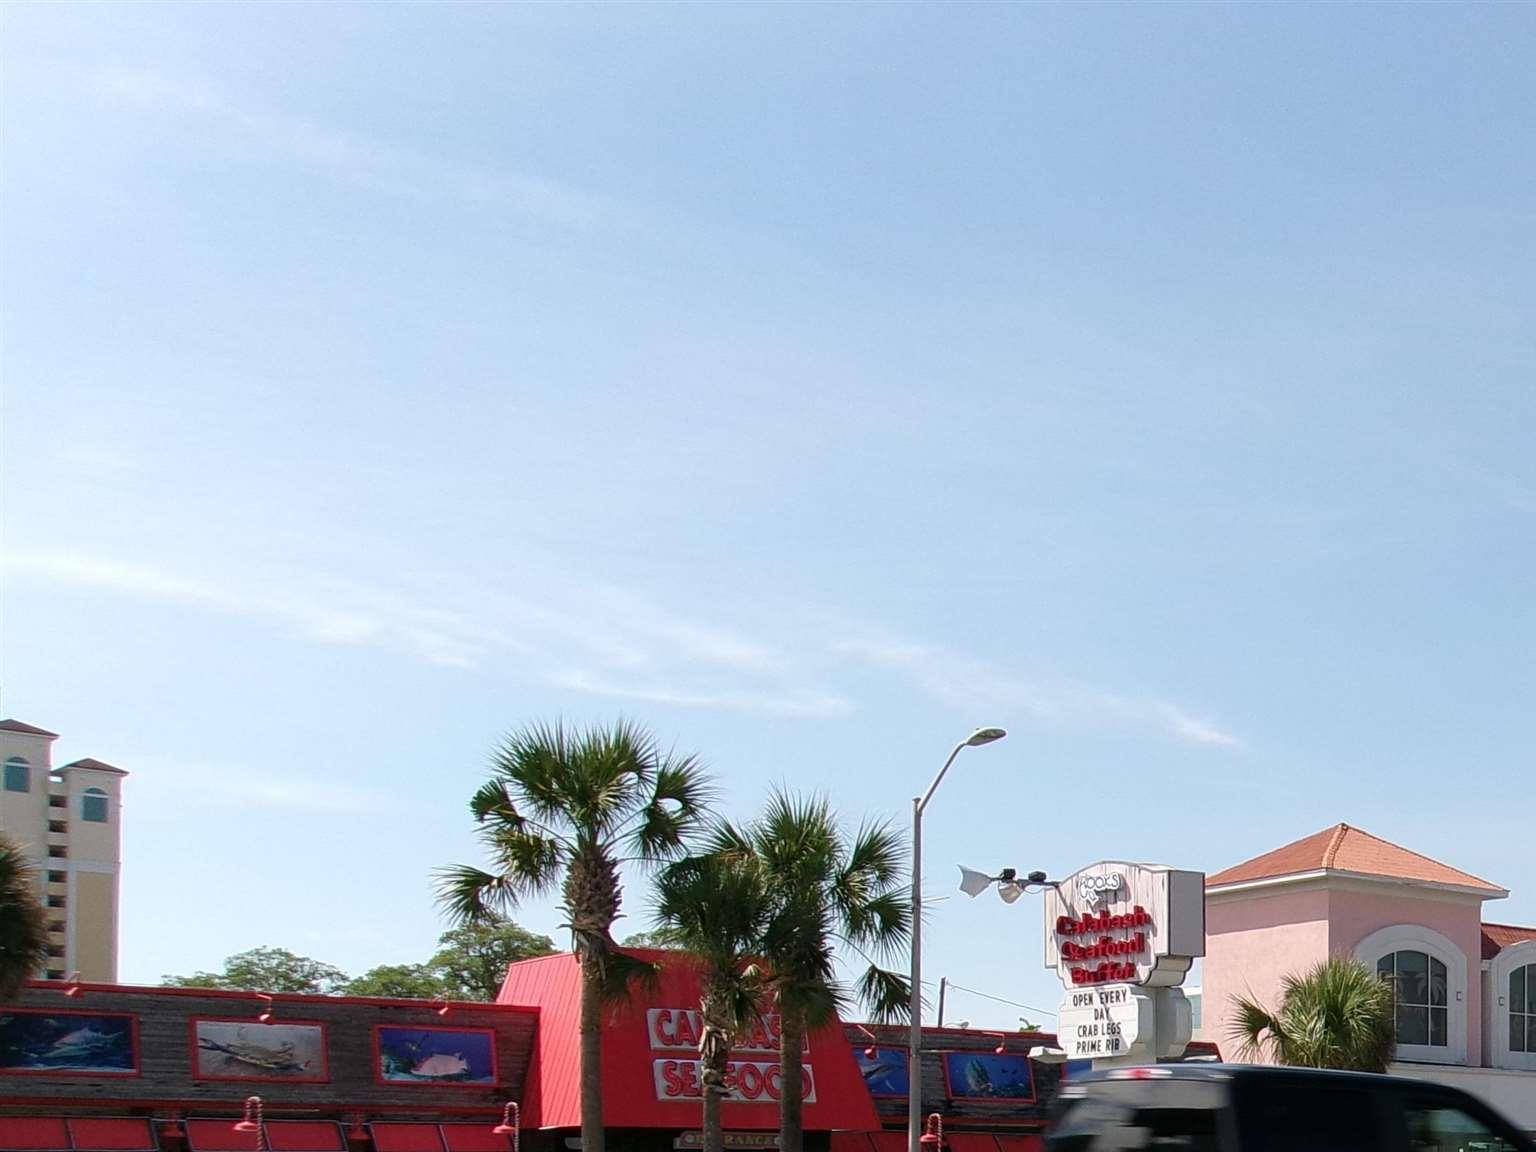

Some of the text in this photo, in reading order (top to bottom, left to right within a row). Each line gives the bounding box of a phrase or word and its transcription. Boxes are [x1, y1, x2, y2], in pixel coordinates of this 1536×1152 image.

[1061, 932, 1145, 961] Seafood
[1073, 989, 1127, 1007] OPEN EVERY
[1094, 1008, 1110, 1020] DAY
[656, 1010, 808, 1052] CAAS
[1077, 1022, 1121, 1038] CRAB LEGS
[1076, 1038, 1120, 1053] PRIME RIB
[663, 1060, 812, 1102] SEFOO
